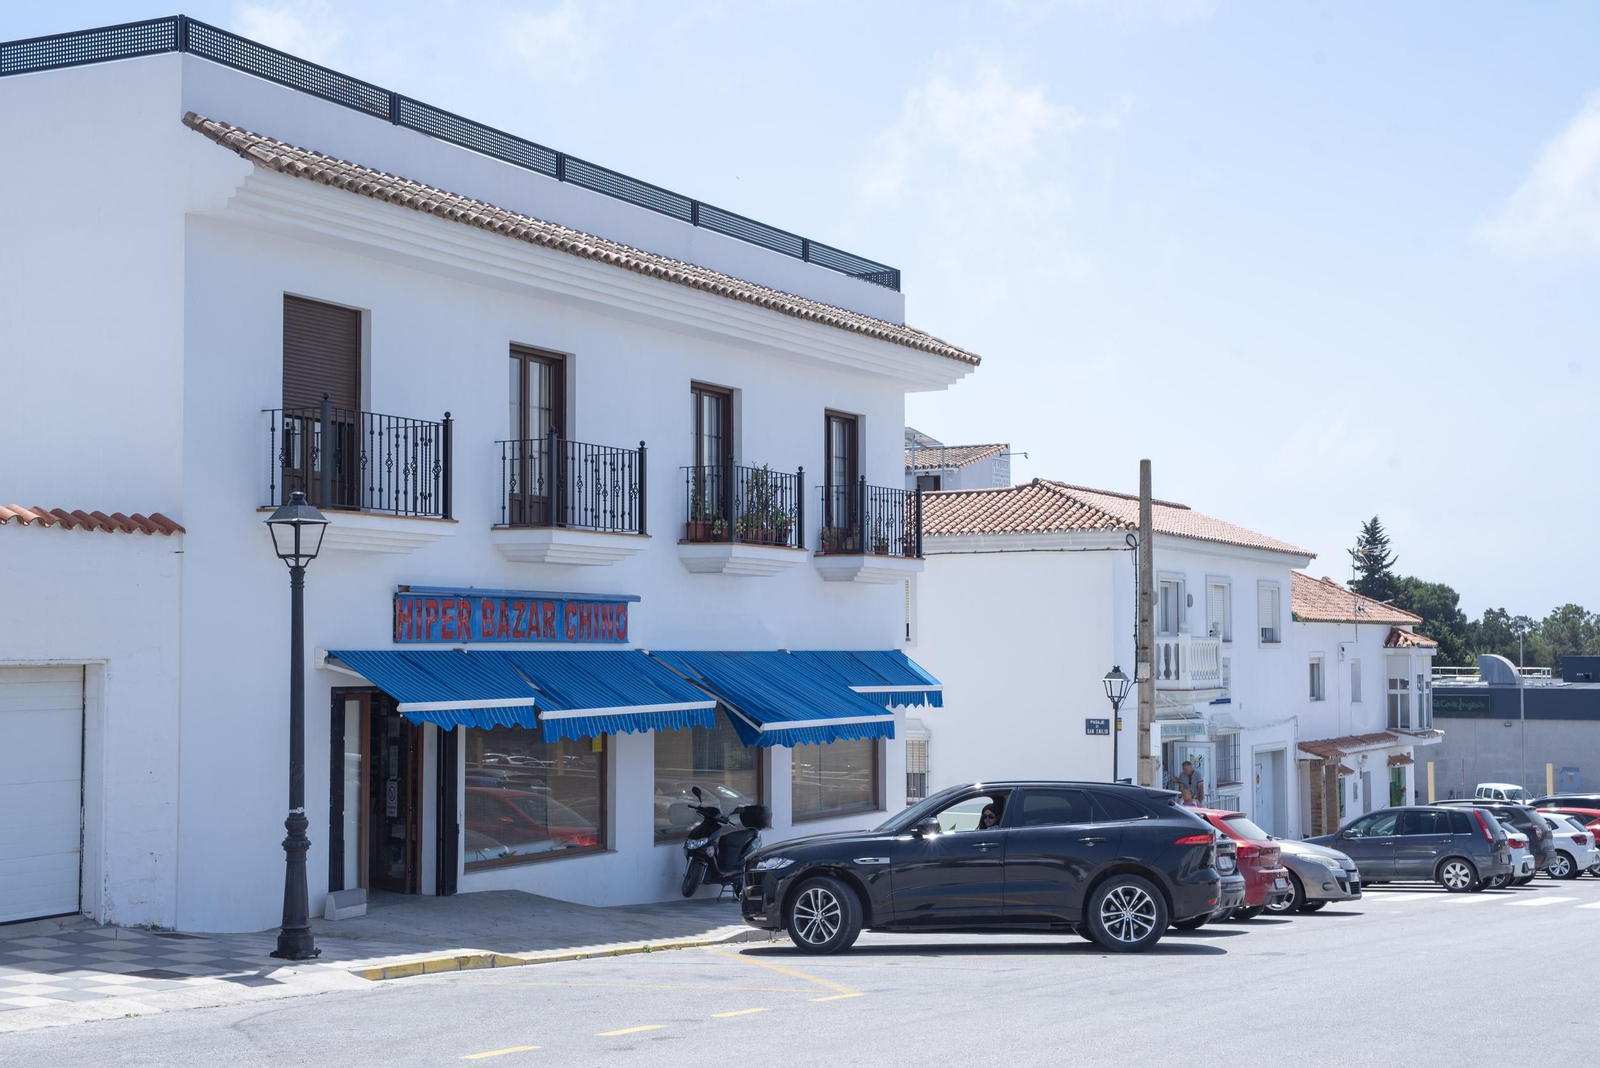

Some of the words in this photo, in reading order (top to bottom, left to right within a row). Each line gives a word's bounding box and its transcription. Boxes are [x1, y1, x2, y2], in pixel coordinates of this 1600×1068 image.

[397, 598, 472, 640] HIPER
[481, 600, 556, 639] BAZAR
[564, 602, 628, 640] CHINO
